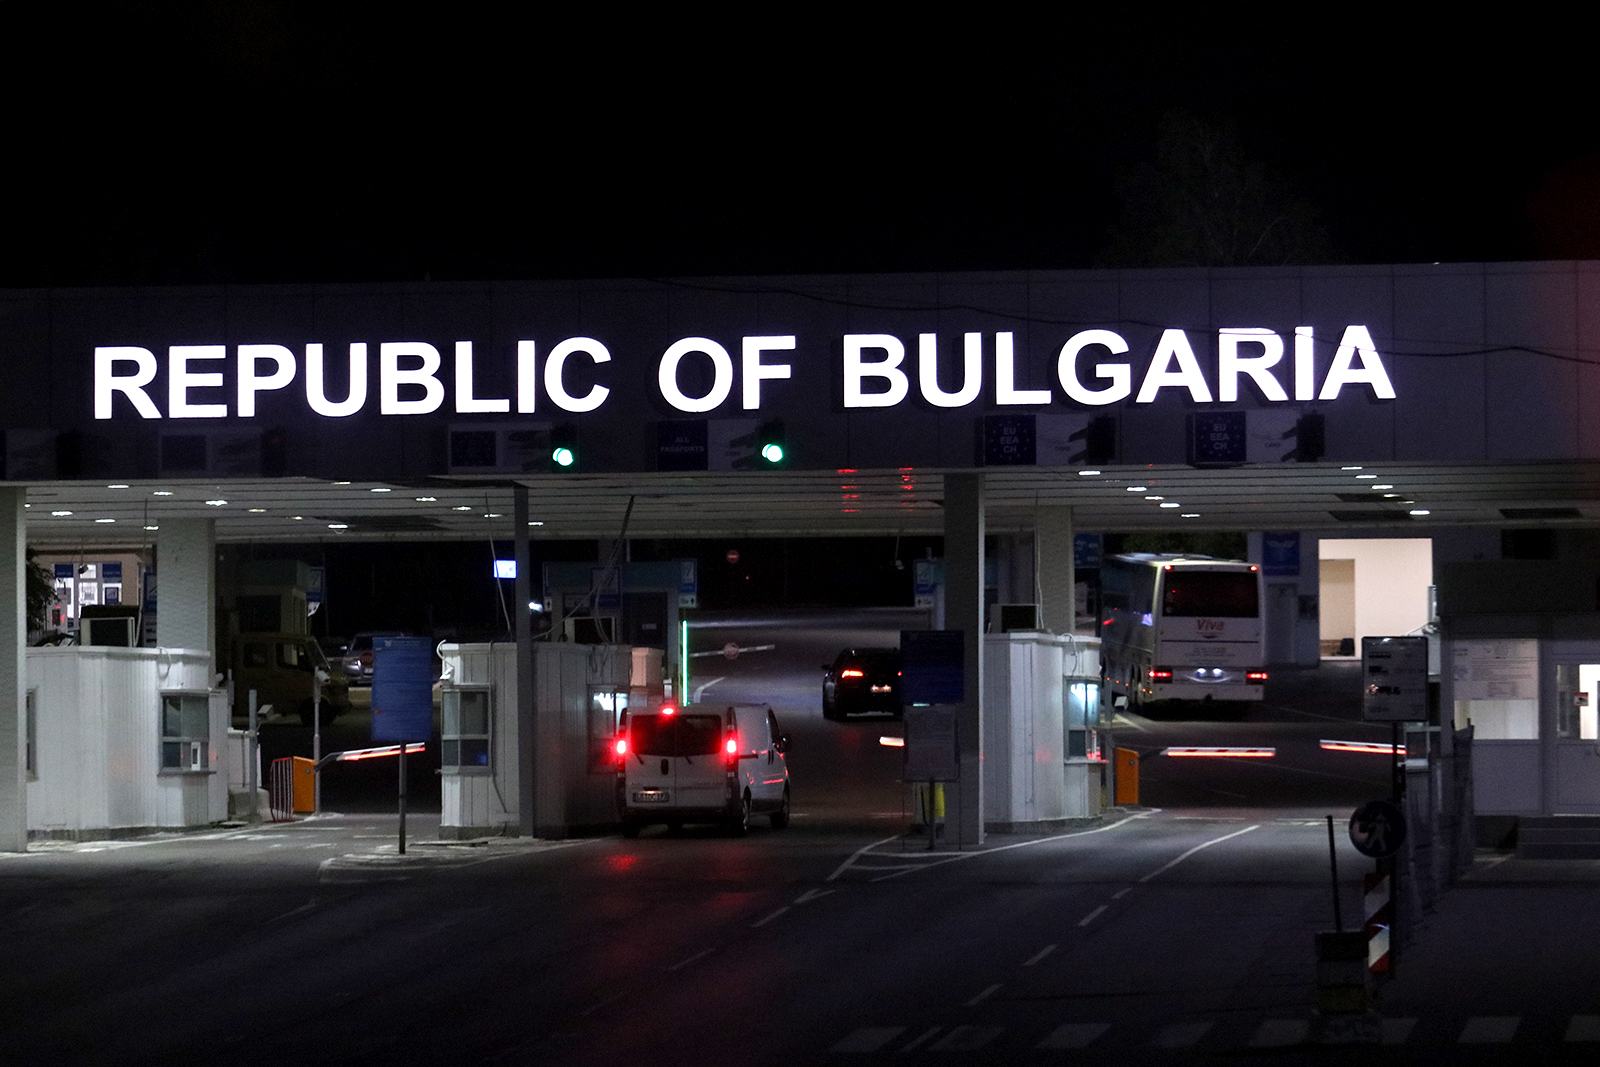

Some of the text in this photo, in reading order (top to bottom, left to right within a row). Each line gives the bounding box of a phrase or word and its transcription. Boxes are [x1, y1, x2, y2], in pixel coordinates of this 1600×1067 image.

[94, 325, 1397, 420] REPUBLIC OF BULGARIA
[1003, 427, 1016, 435] EU
[1213, 423, 1226, 431] EU
[1000, 436, 1019, 444] EEA
[1210, 433, 1229, 441] EEA
[1003, 446, 1017, 454] CH
[1197, 619, 1225, 631] Viva
